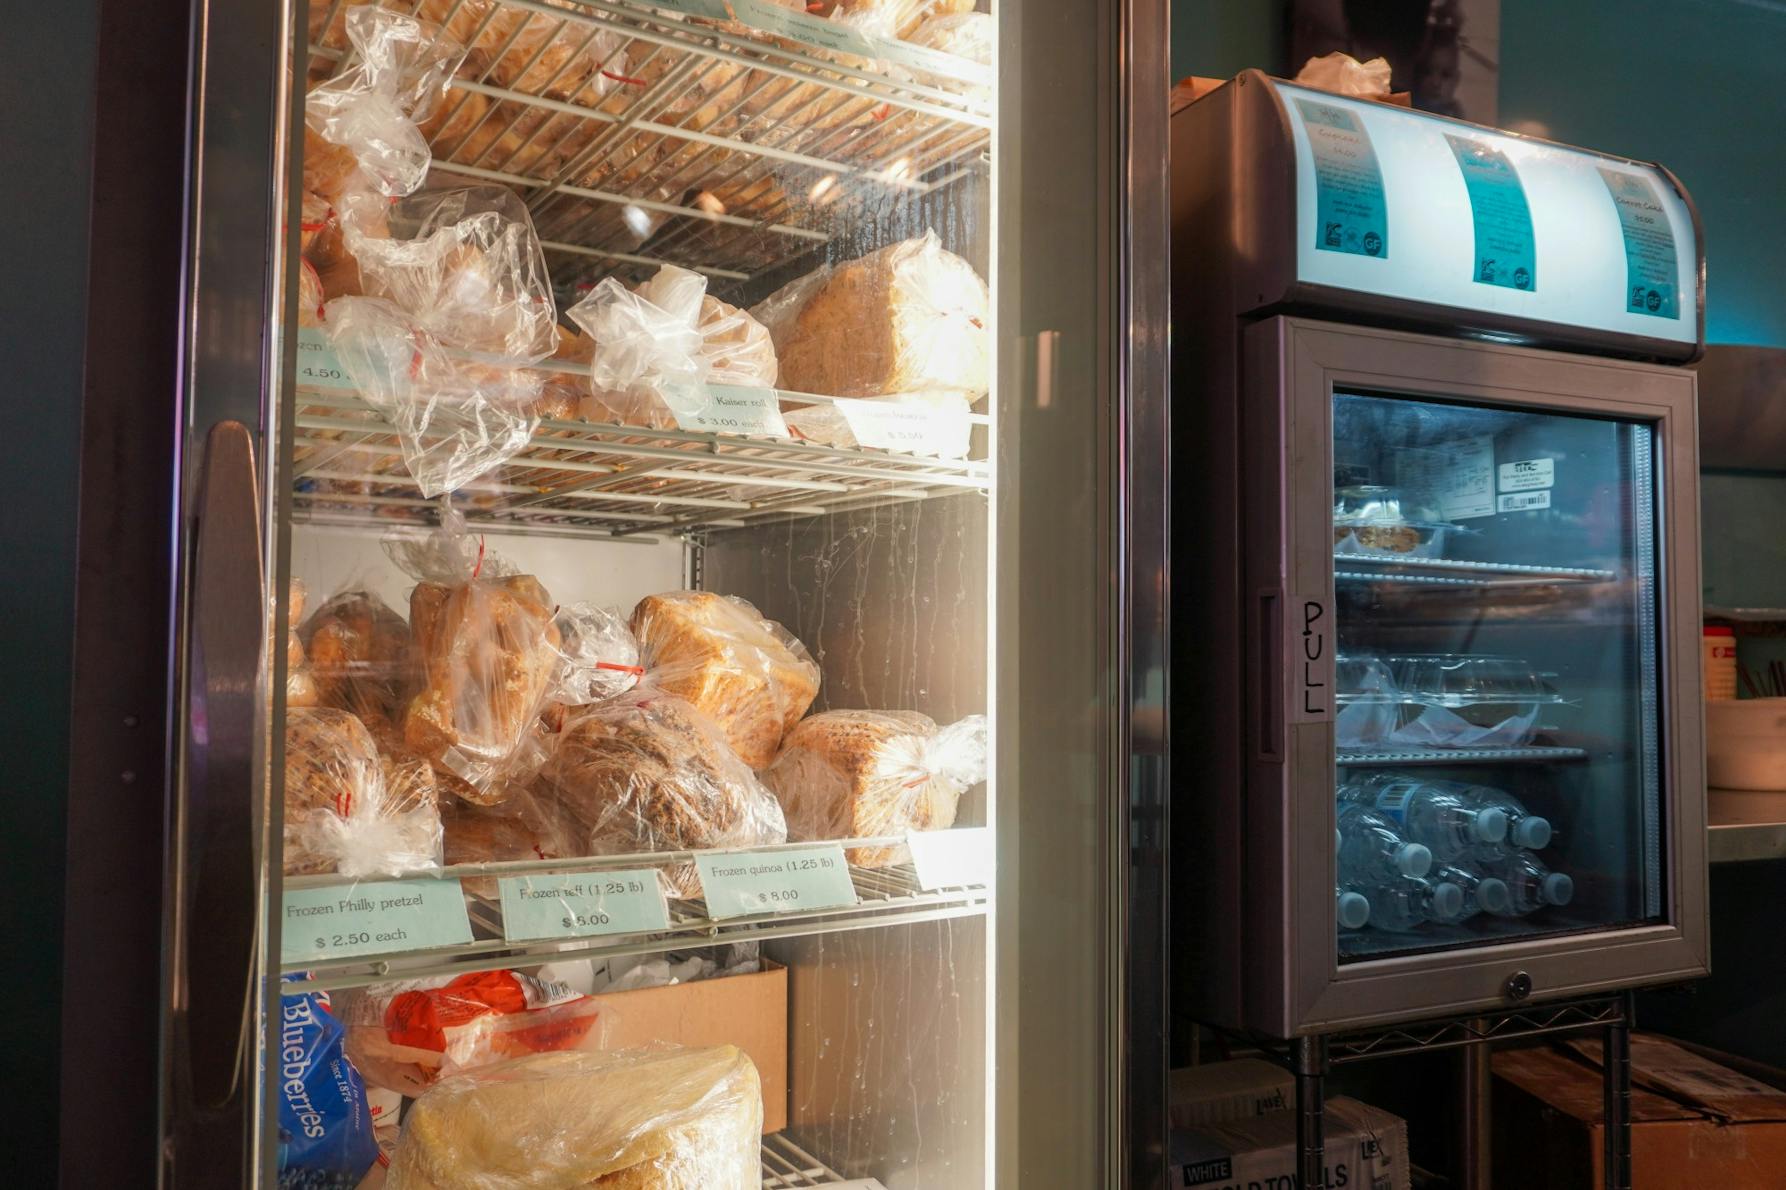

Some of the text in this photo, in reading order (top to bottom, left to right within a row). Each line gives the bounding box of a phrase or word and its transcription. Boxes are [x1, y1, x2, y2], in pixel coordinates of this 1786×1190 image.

[1365, 237, 1382, 250] GF
[302, 367, 341, 379] 4.50
[716, 396, 748, 407] Kaiser
[1303, 601, 1325, 713] PULL
[711, 857, 835, 879] Frozen quinoa (1.25 lb)
[628, 880, 645, 893] lb)
[759, 889, 799, 902] $ 8.00
[287, 893, 424, 918] Frozen Philly pretzel
[562, 916, 572, 929] $
[315, 928, 408, 949] $ 2.50 each
[283, 997, 325, 1140] Blueberries
[1187, 1160, 1229, 1184] WHITE
